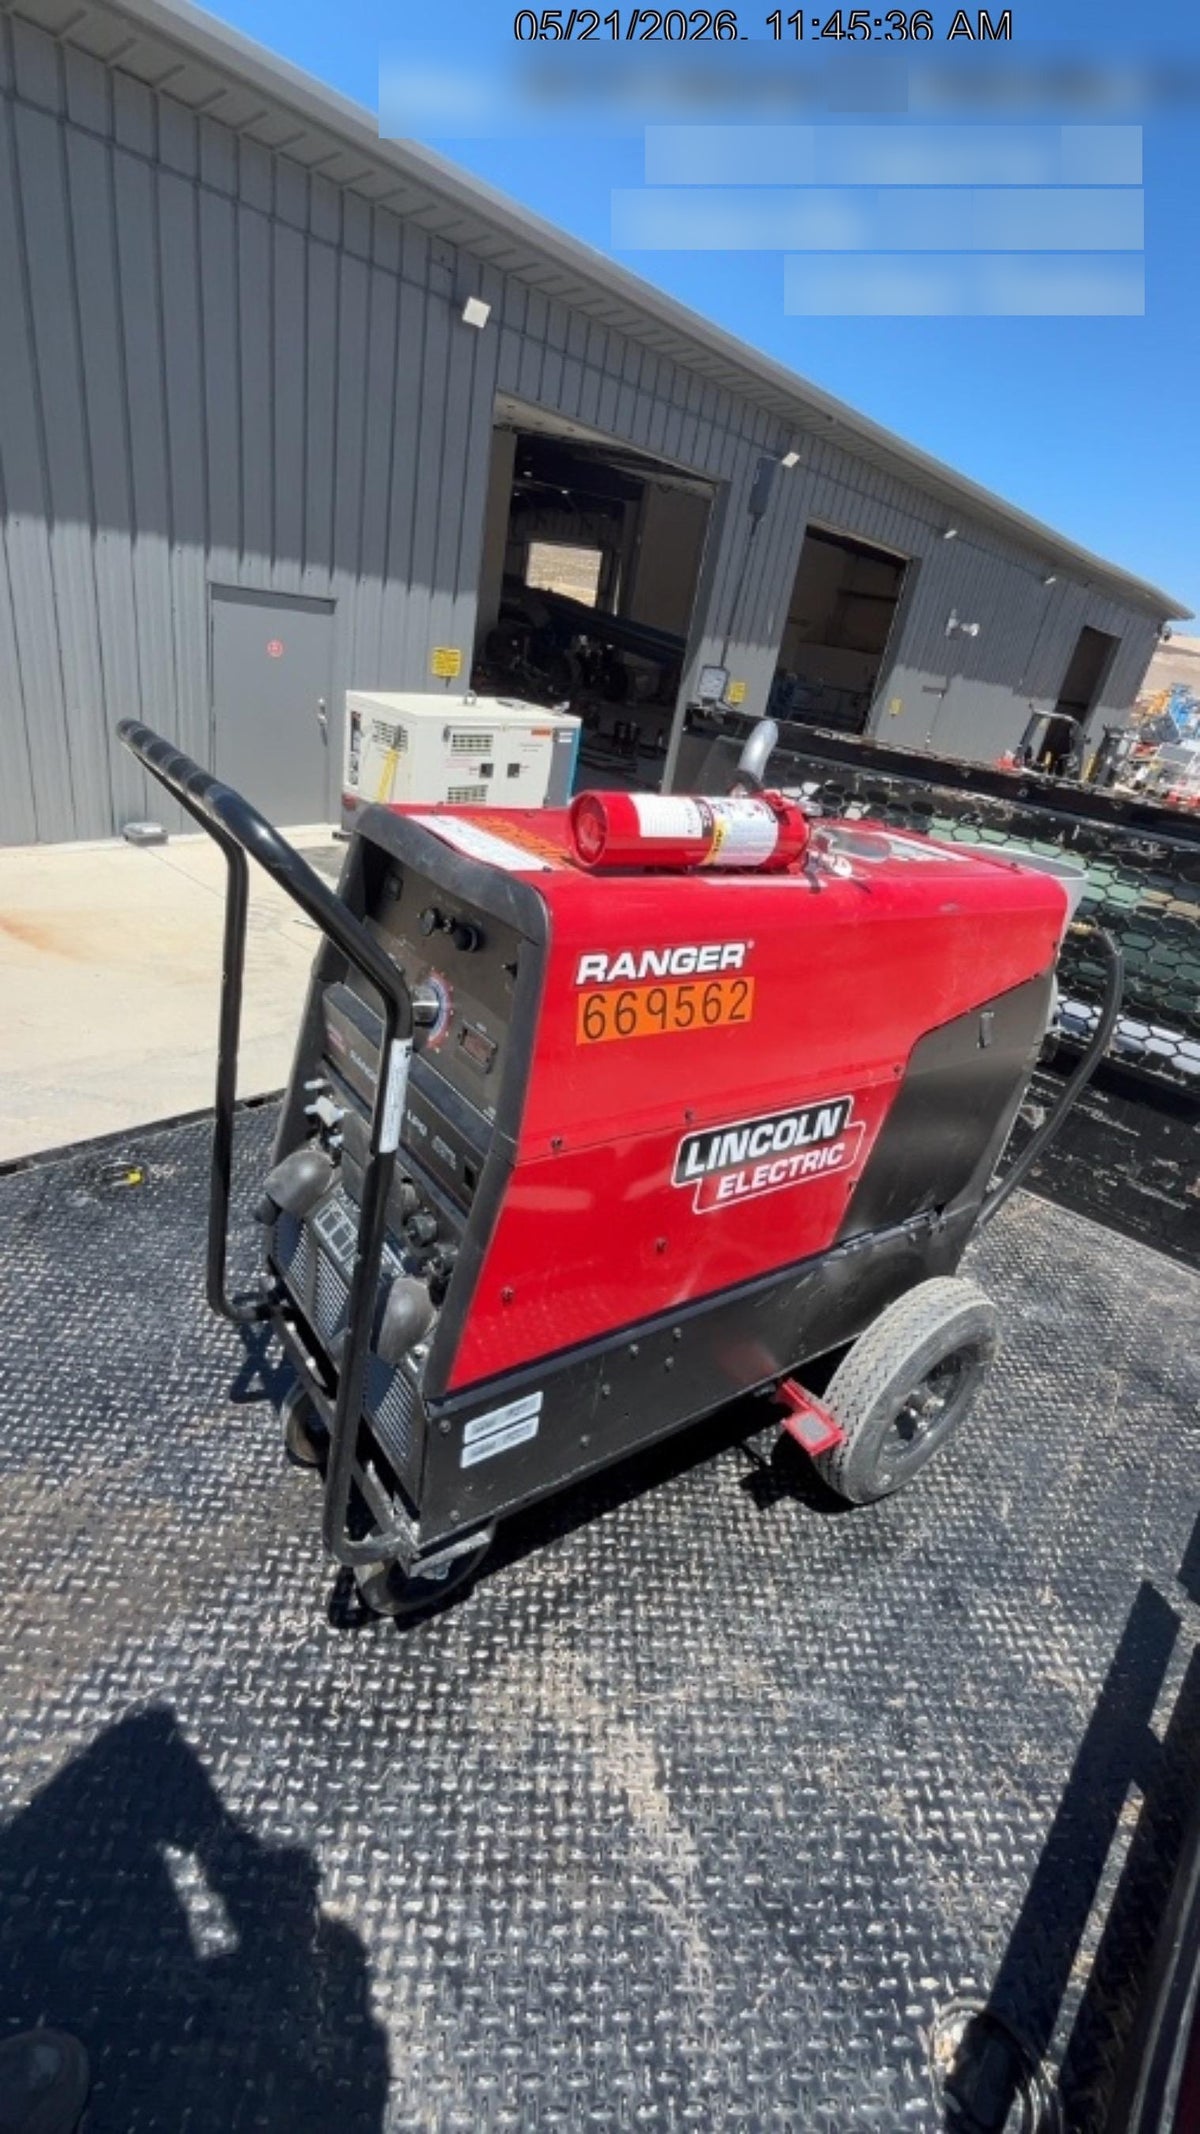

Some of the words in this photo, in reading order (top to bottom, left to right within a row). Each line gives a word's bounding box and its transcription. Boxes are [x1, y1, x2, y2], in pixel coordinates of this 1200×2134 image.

[582, 979, 748, 1040] 669562
[685, 1105, 843, 1177] LINCOLN
[716, 1142, 845, 1201] ELECTRIC
